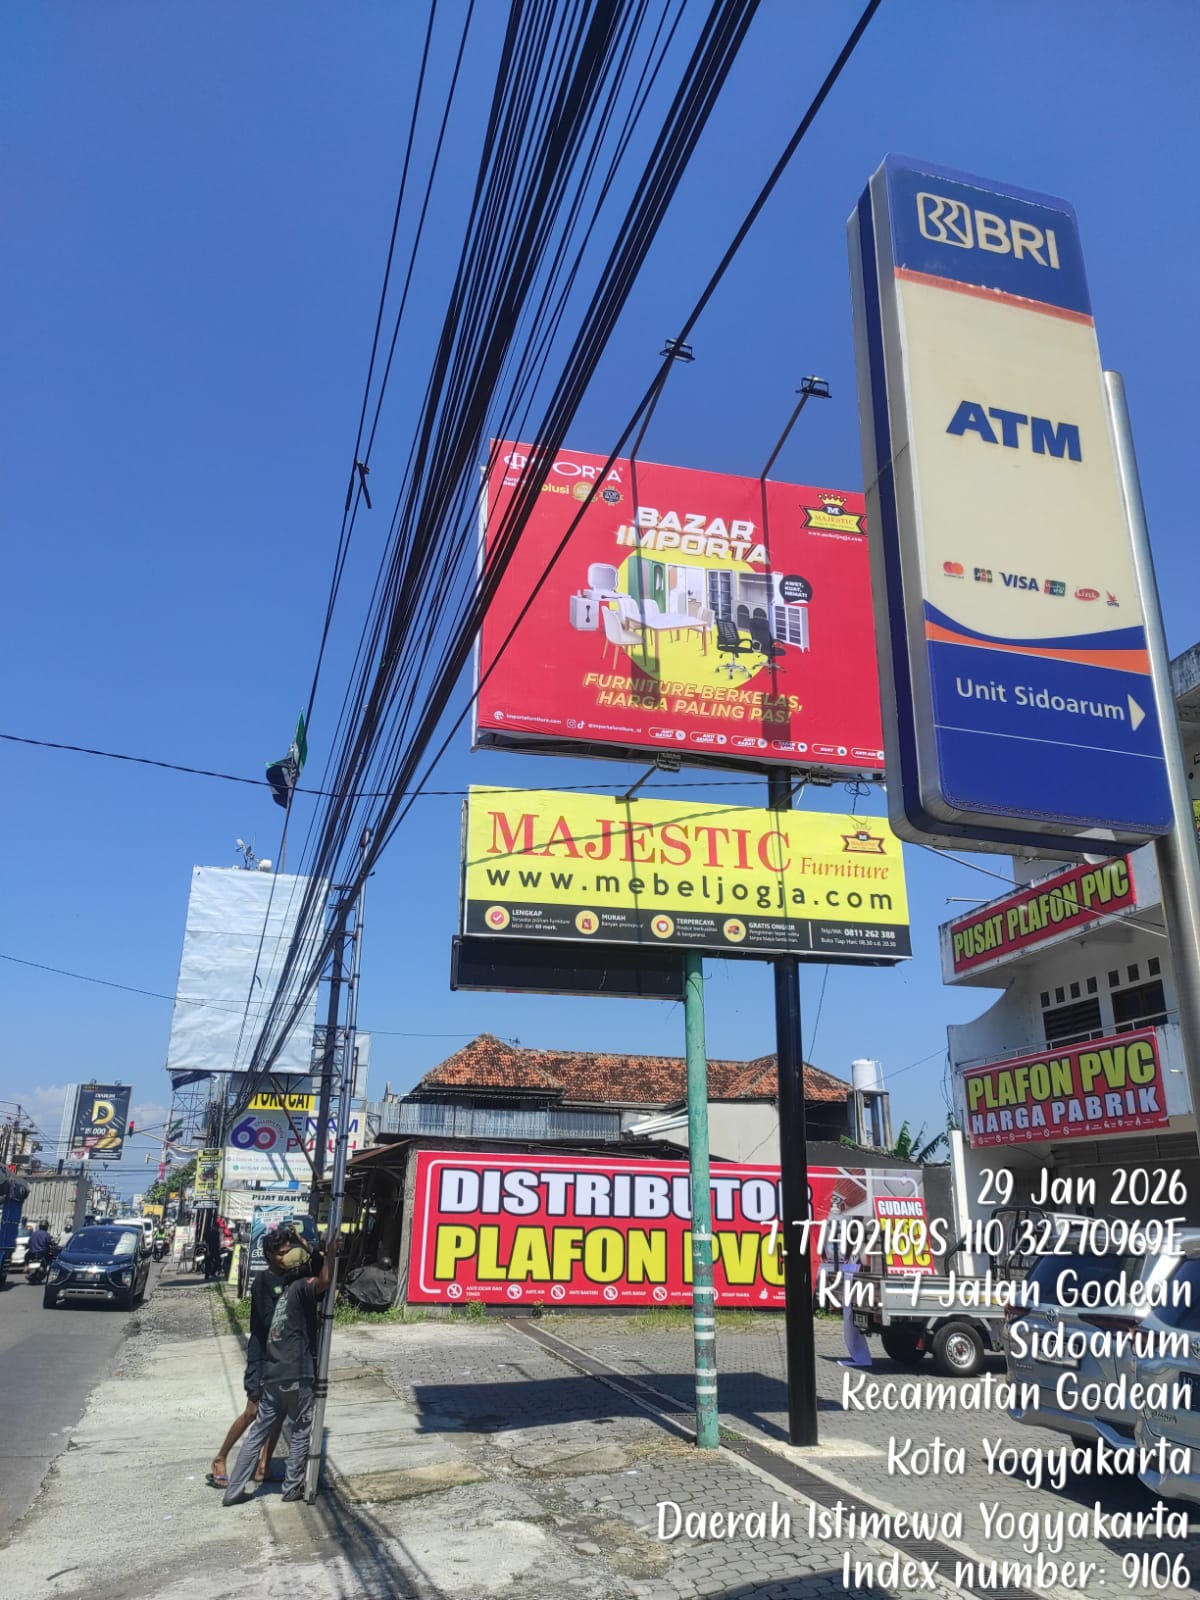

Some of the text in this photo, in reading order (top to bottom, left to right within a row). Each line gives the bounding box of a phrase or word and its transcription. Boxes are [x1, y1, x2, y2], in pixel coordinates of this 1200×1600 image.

[975, 209, 1060, 270] BRI
[946, 400, 1083, 463] ATM
[634, 506, 756, 542] BAZAR
[616, 525, 770, 565] IMPORTA
[998, 571, 1040, 592] VISA
[583, 671, 804, 712] FURNITURE BERKELAS,
[596, 691, 793, 725] HARGA PALING PAS!
[956, 676, 1126, 721] Unit Sidoarum
[486, 811, 793, 874] MAJESTIC
[486, 866, 894, 912] www.mebeljogja.com
[800, 857, 890, 881] Furniture
[512, 909, 543, 917] LENGKAP
[602, 913, 627, 921] MURAH
[676, 918, 715, 926] TERPERCAYA
[953, 858, 1130, 964] PUSAT PLAFON PVC
[966, 1040, 1158, 1113] PLAFON PVC
[971, 1103, 1046, 1137] HARGA
[1051, 1085, 1161, 1126] PABRIK
[230, 1116, 277, 1150] 60
[877, 1200, 924, 1217] GUDANG
[433, 1223, 669, 1285] PLAFON
